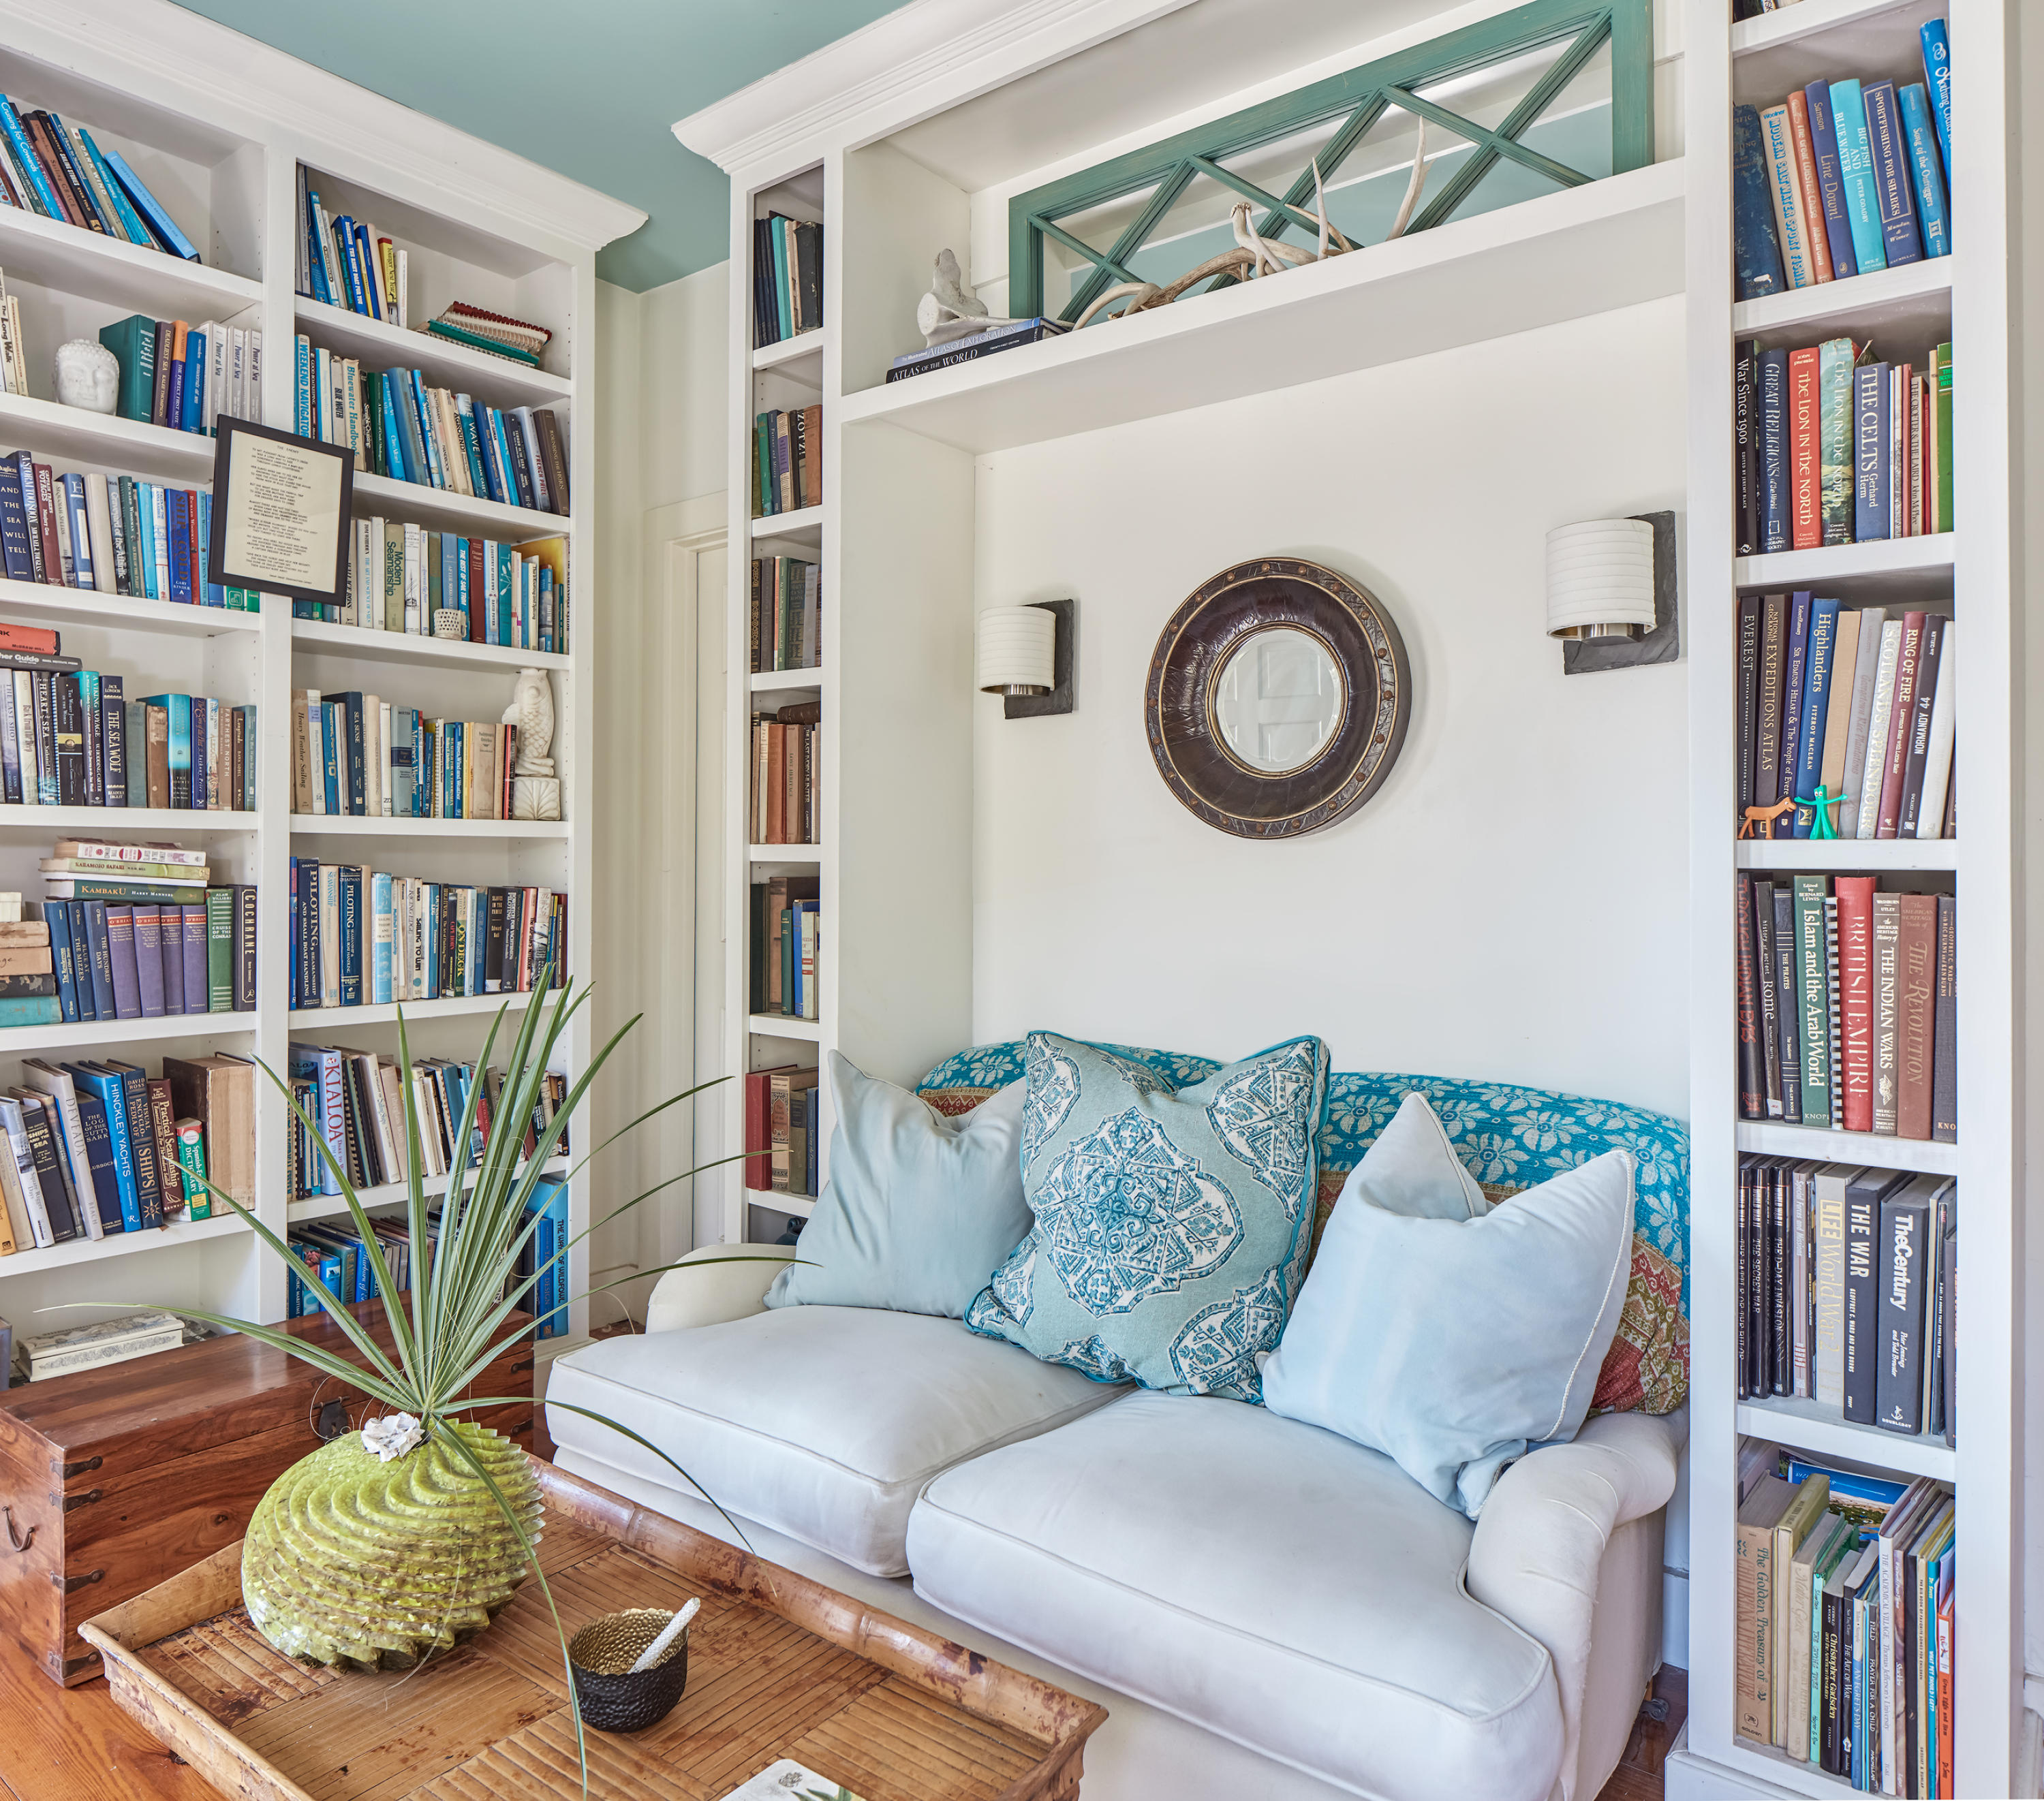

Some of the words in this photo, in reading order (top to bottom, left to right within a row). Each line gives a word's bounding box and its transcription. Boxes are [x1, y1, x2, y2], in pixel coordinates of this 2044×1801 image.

[1814, 102, 1826, 131] Samson
[1874, 91, 1892, 158] SPORTFISHING
[1, 102, 18, 129] Cruising
[14, 130, 23, 140] for
[20, 142, 37, 172] Cowards
[1858, 127, 1868, 144] BIG
[1913, 127, 1924, 146] Song
[80, 144, 94, 169] DARK
[93, 172, 108, 195] WIND
[1821, 154, 1836, 179] Line
[1851, 148, 1861, 170] AND
[1861, 146, 1871, 168] FISH
[1885, 159, 1895, 177] FOR
[1919, 156, 1927, 168] the
[1825, 183, 1842, 220] Down!
[1887, 180, 1901, 216] SHARKS
[1920, 170, 1935, 207] Outriggers
[300, 345, 309, 386] WEEKEND
[892, 366, 920, 381] ATLAS
[942, 349, 978, 366] WORLD
[1737, 358, 1750, 381] War
[1738, 383, 1750, 416] Since
[1861, 368, 1878, 409] THE
[300, 388, 309, 437] NAVIGATOR
[468, 422, 480, 452] WAVE
[1735, 419, 1748, 444] 1900
[1861, 412, 1878, 471] CELTS
[535, 455, 543, 477] FRENCH
[1859, 474, 1868, 498] Herm
[1868, 473, 1878, 507] Gerhard
[385, 541, 397, 596] Seamanship
[394, 551, 404, 586] Modern
[1743, 615, 1754, 670] EVEREST
[1812, 612, 1831, 693] Highlanders
[1904, 629, 1918, 657] RING
[1791, 660, 1800, 687] EDMUND
[1902, 659, 1915, 675] OF
[40, 683, 48, 714] HEART
[1763, 645, 1776, 727] EXPEDITIONS
[1899, 676, 1913, 703] FIRE
[1788, 689, 1799, 715] HILLARY
[108, 711, 120, 730] THE
[1787, 727, 1796, 740] The
[1788, 717, 1797, 725] &
[1809, 705, 1818, 735] FITZROY
[108, 732, 120, 747] SEA
[1761, 732, 1773, 770] ATLAS
[1784, 742, 1795, 765] People
[1806, 737, 1816, 770] MACLEAN
[109, 748, 121, 774] WOLF
[1783, 777, 1792, 795] Evere
[310, 870, 319, 950] PILOTING,
[346, 885, 354, 928] PILOTING
[245, 894, 255, 954] COCHRANE
[457, 924, 465, 942] ON
[1803, 909, 1821, 949] Islam
[416, 946, 421, 956] TO
[457, 943, 465, 977] DECK
[1806, 951, 1821, 977] and
[1881, 947, 1894, 976] THE
[76, 954, 84, 982] MIZZEN
[84, 965, 90, 973] AT
[1806, 980, 1823, 1001] the
[1880, 977, 1893, 1027] INDIAN
[1806, 1005, 1824, 1039] Arab
[1808, 1041, 1825, 1086] World
[1880, 1032, 1893, 1069] WARS
[130, 1101, 138, 1126] PEDIA
[324, 1065, 344, 1142] KIALOA
[110, 1084, 124, 1135] HINCKLEY
[118, 1138, 130, 1177] YACHTS
[132, 1128, 140, 1138] OF
[139, 1147, 155, 1189] SHIPS
[1821, 1200, 1842, 1240] LIFE
[1851, 1204, 1870, 1234] THE
[558, 1256, 564, 1265] OF
[1851, 1241, 1869, 1278] WAR
[1829, 1633, 1838, 1682] Christopher
[1844, 1674, 1851, 1682] OF
[1844, 1683, 1852, 1699] WAR
[1829, 1683, 1838, 1719] Gadsden
